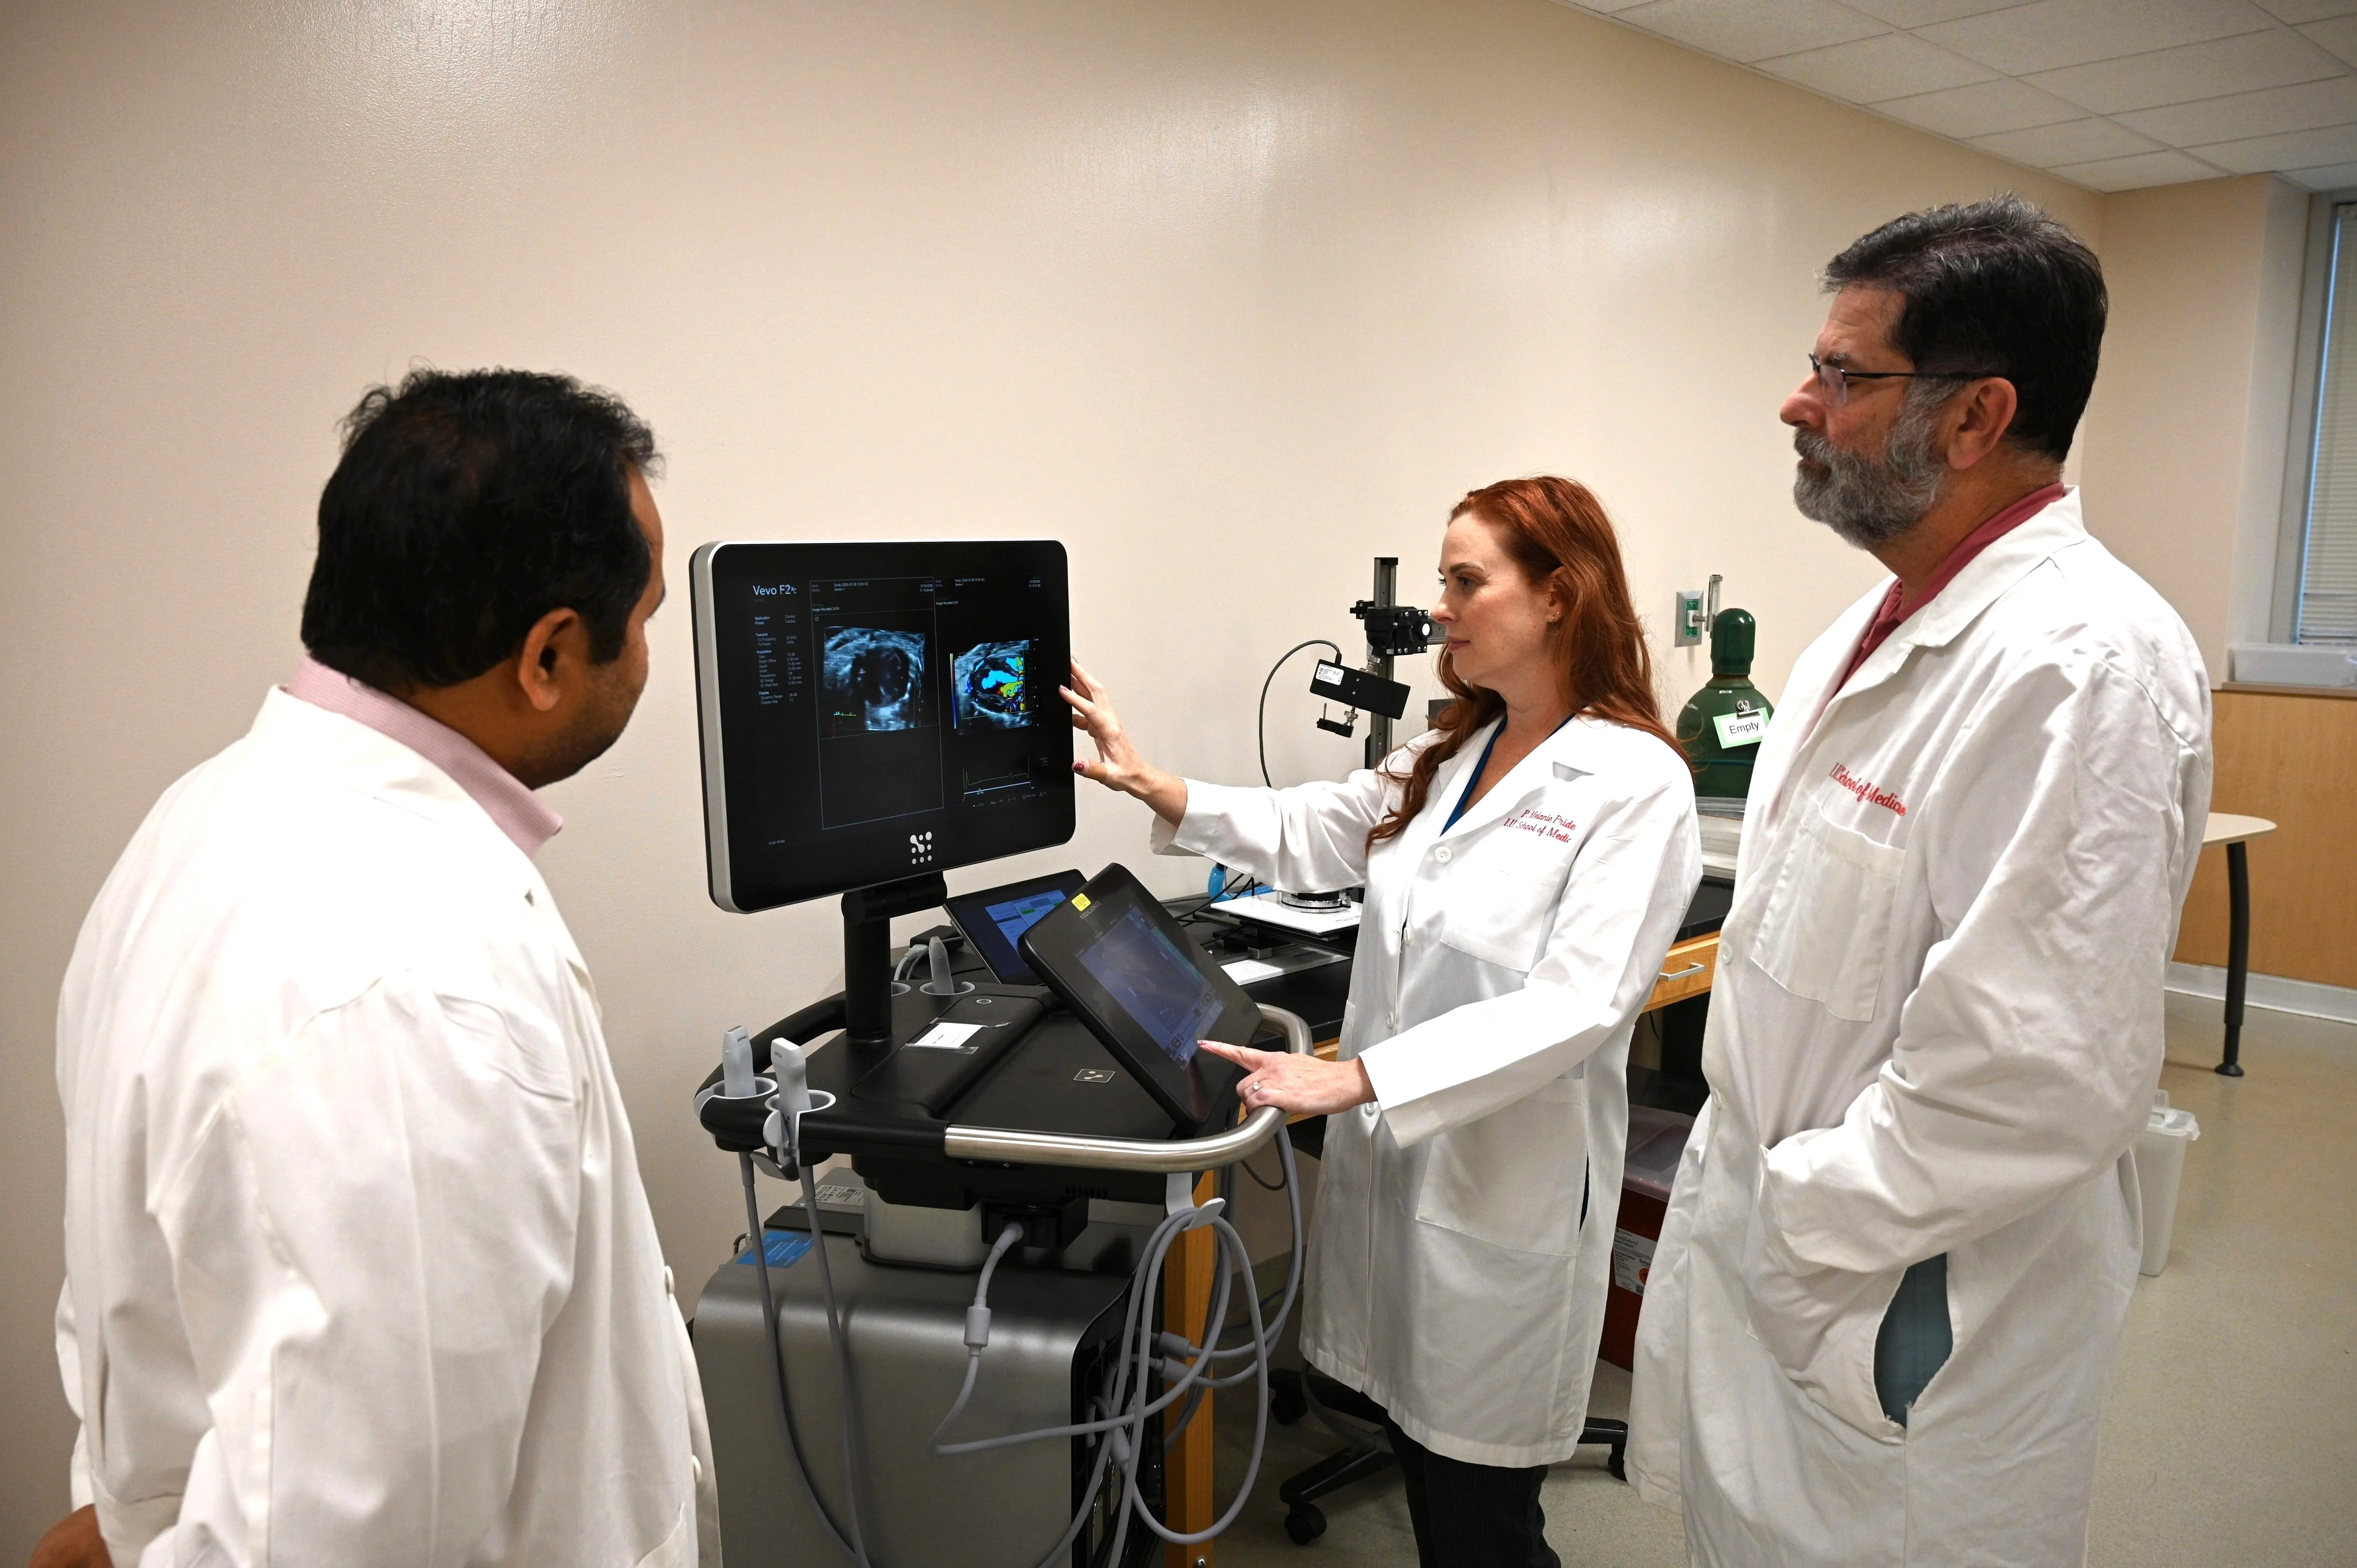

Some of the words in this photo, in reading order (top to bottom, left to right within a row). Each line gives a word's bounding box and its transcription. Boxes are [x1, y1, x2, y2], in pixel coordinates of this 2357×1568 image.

[753, 586, 777, 595] Vevo
[1729, 722, 1759, 733] Empty
[1856, 782, 1870, 802] of
[1503, 818, 1518, 828] I.U.
[1516, 821, 1537, 832] School
[1537, 826, 1547, 836] of
[1528, 810, 1553, 822] Melanie
[1553, 815, 1576, 830] Pride
[1079, 901, 1101, 920] VISUALSONICS
